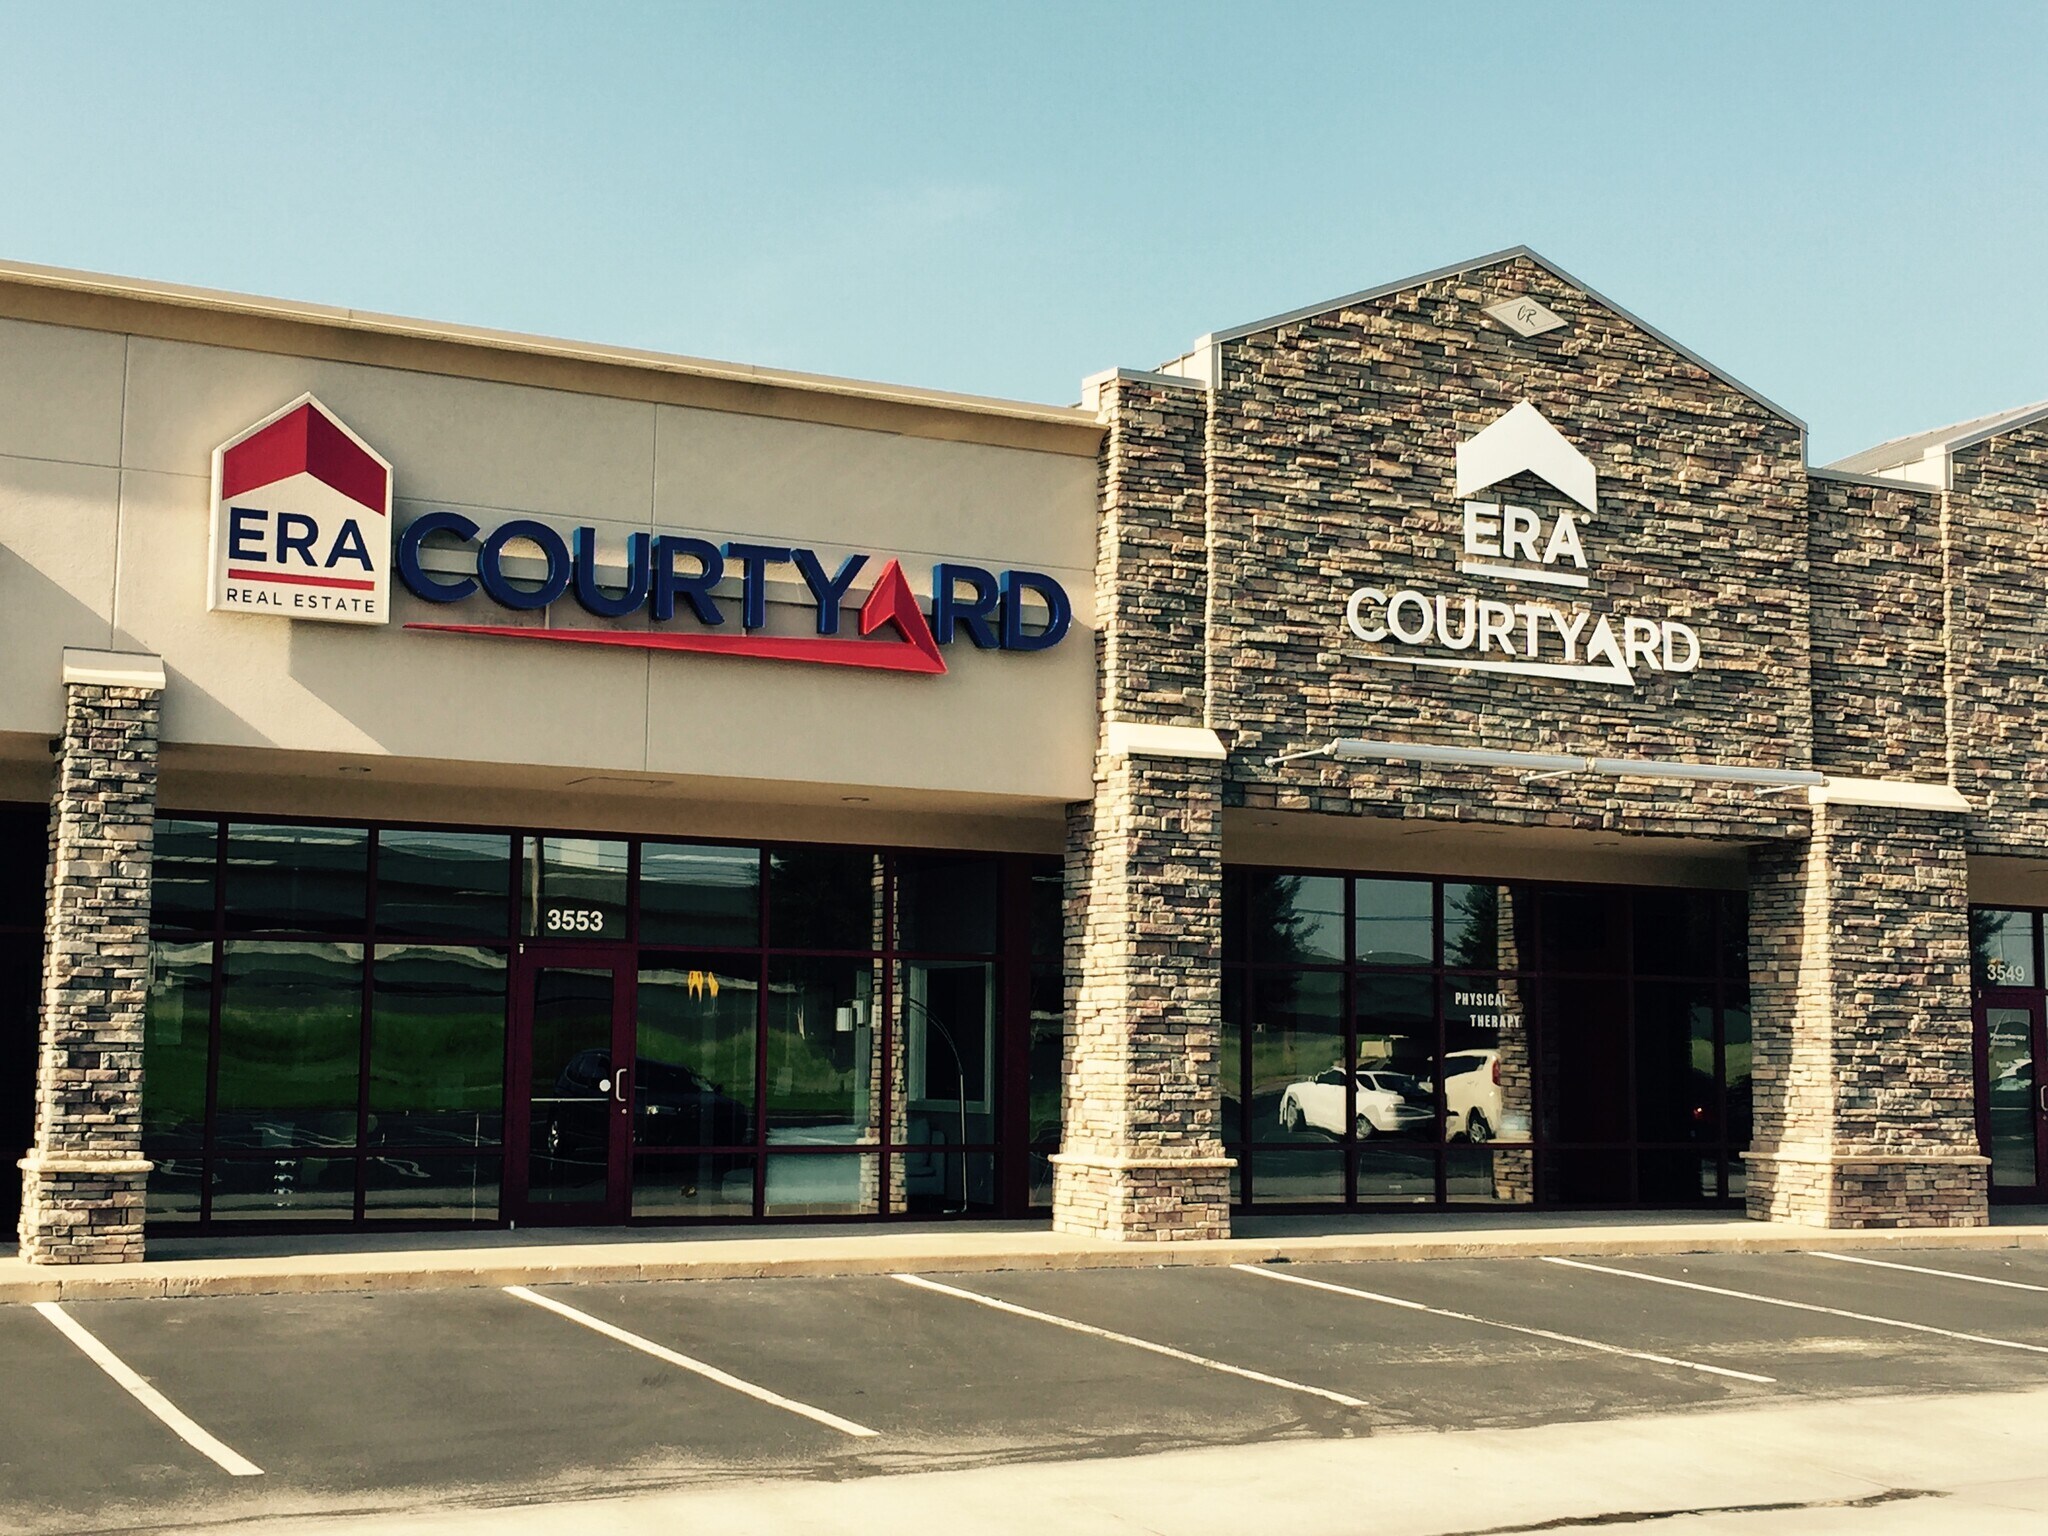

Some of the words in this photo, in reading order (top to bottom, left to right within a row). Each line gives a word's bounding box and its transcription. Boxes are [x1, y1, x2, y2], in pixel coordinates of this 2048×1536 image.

[229, 507, 374, 572] ERA
[1464, 501, 1588, 568] ERA
[227, 588, 282, 606] REAL
[294, 593, 375, 613] ESTATE
[395, 512, 1072, 673] COURTYARD
[1346, 587, 1700, 686] COURTYARD
[547, 909, 603, 931] 3553
[1987, 964, 2025, 982] 3549
[1455, 992, 1507, 1006] PHYSICAL
[1470, 1014, 1520, 1028] THERAPY
